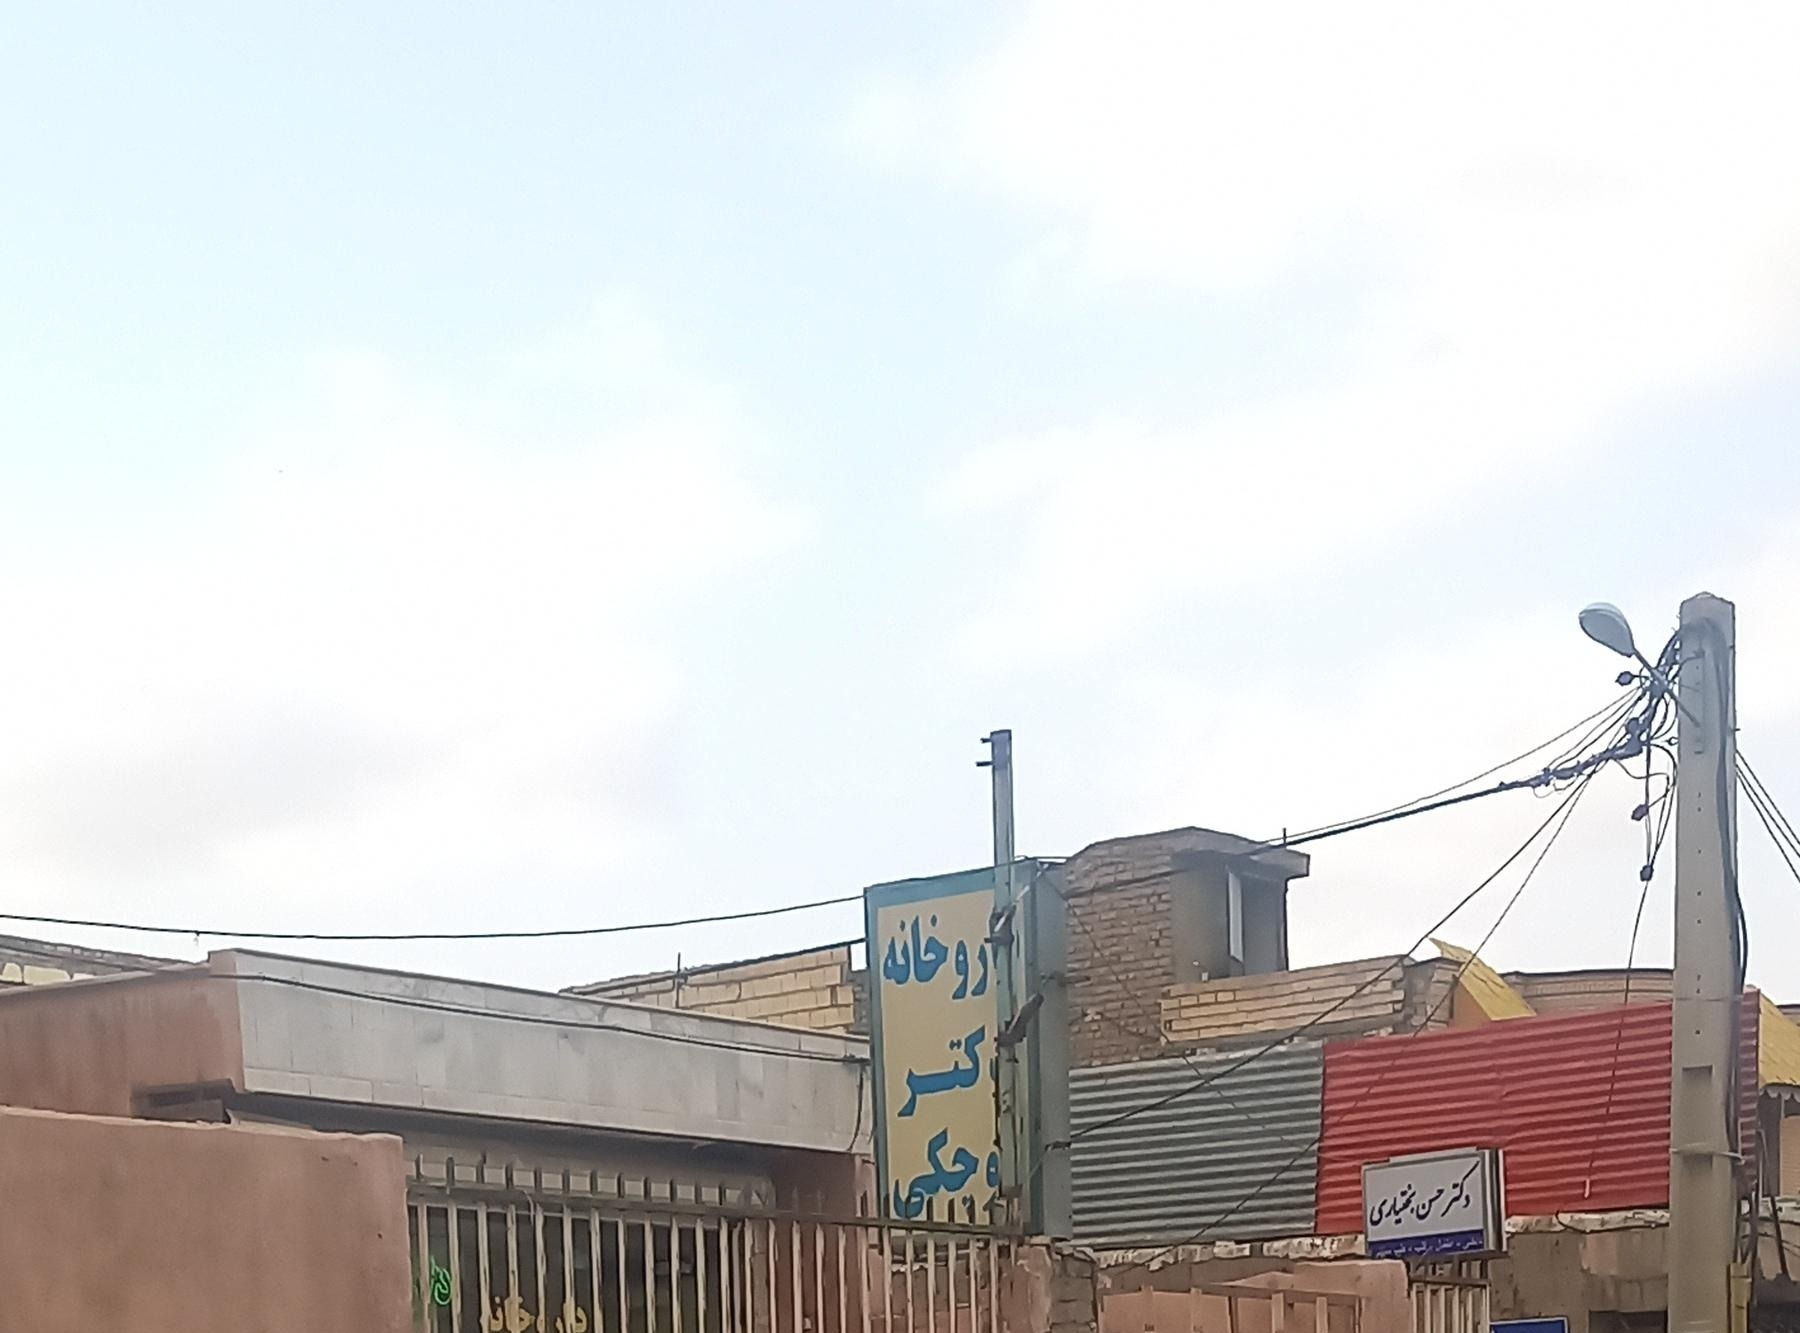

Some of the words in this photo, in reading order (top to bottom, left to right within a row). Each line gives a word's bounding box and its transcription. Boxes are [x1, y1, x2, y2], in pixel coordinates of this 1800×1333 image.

[883, 914, 990, 1000] روخانه
[897, 1025, 998, 1117] کتر
[1369, 1184, 1416, 1226] بختیاری
[1415, 1186, 1445, 1220] حسن
[1441, 1160, 1481, 1217] دکتر
